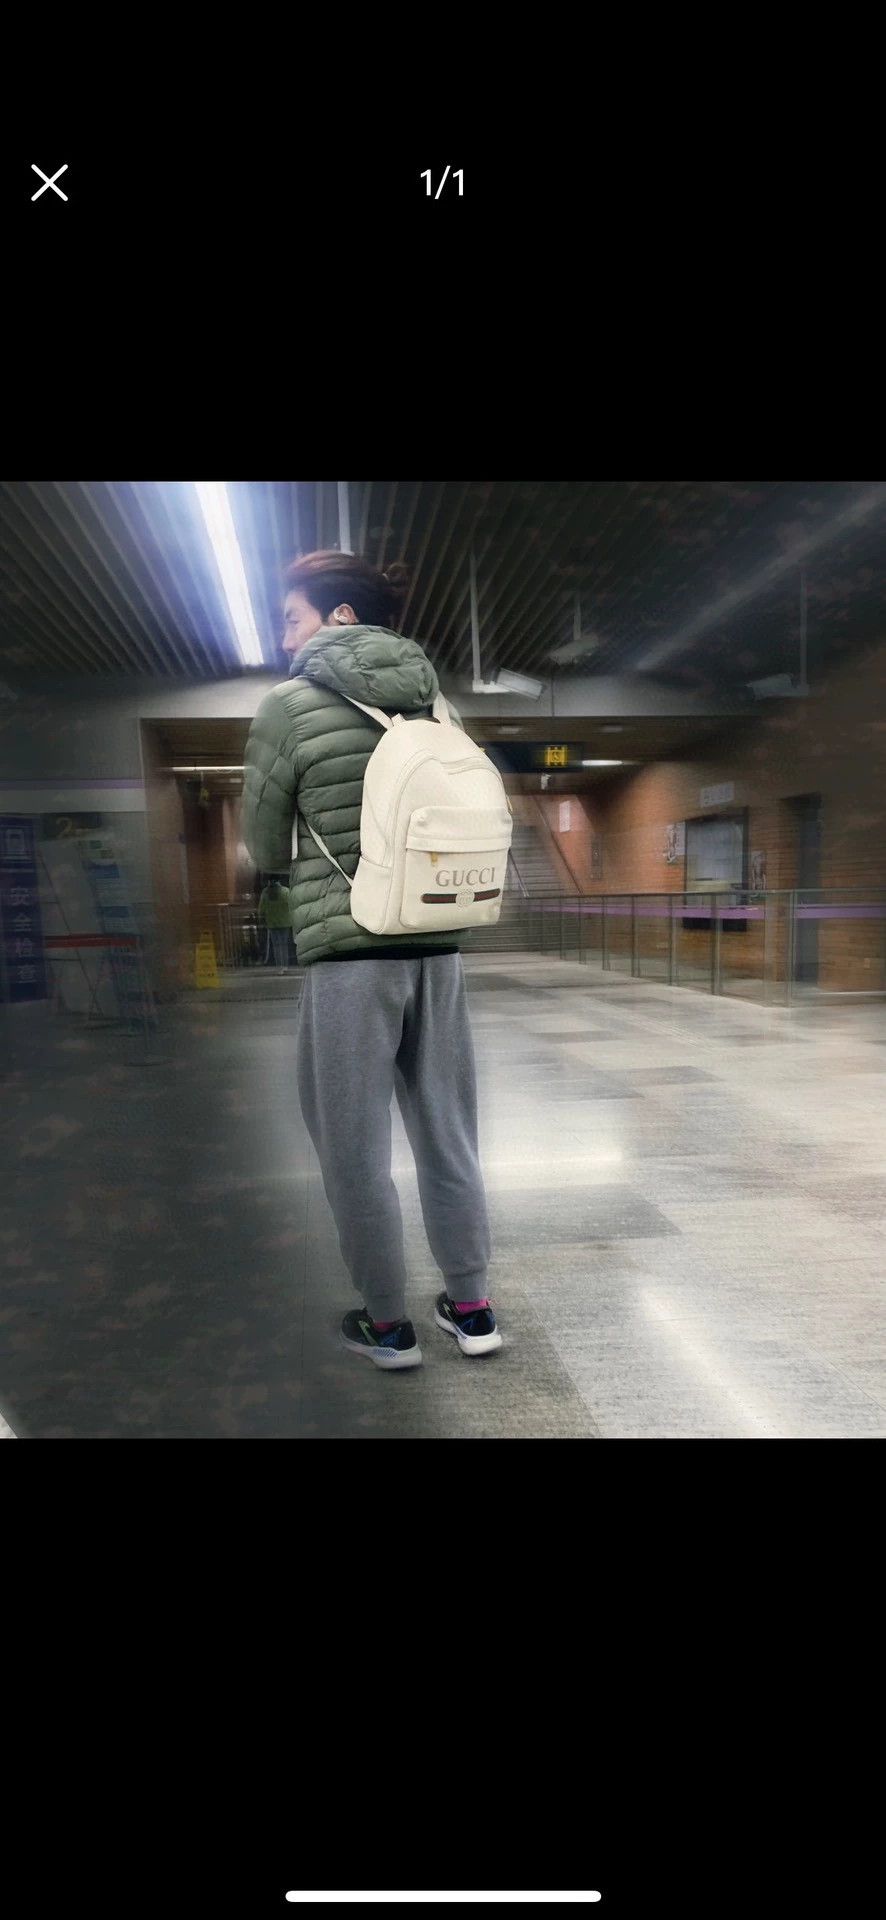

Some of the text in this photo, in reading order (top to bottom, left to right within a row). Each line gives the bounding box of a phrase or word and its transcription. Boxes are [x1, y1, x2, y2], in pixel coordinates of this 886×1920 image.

[435, 867, 496, 887] GUCCI
[9, 886, 37, 983] 安全检查
